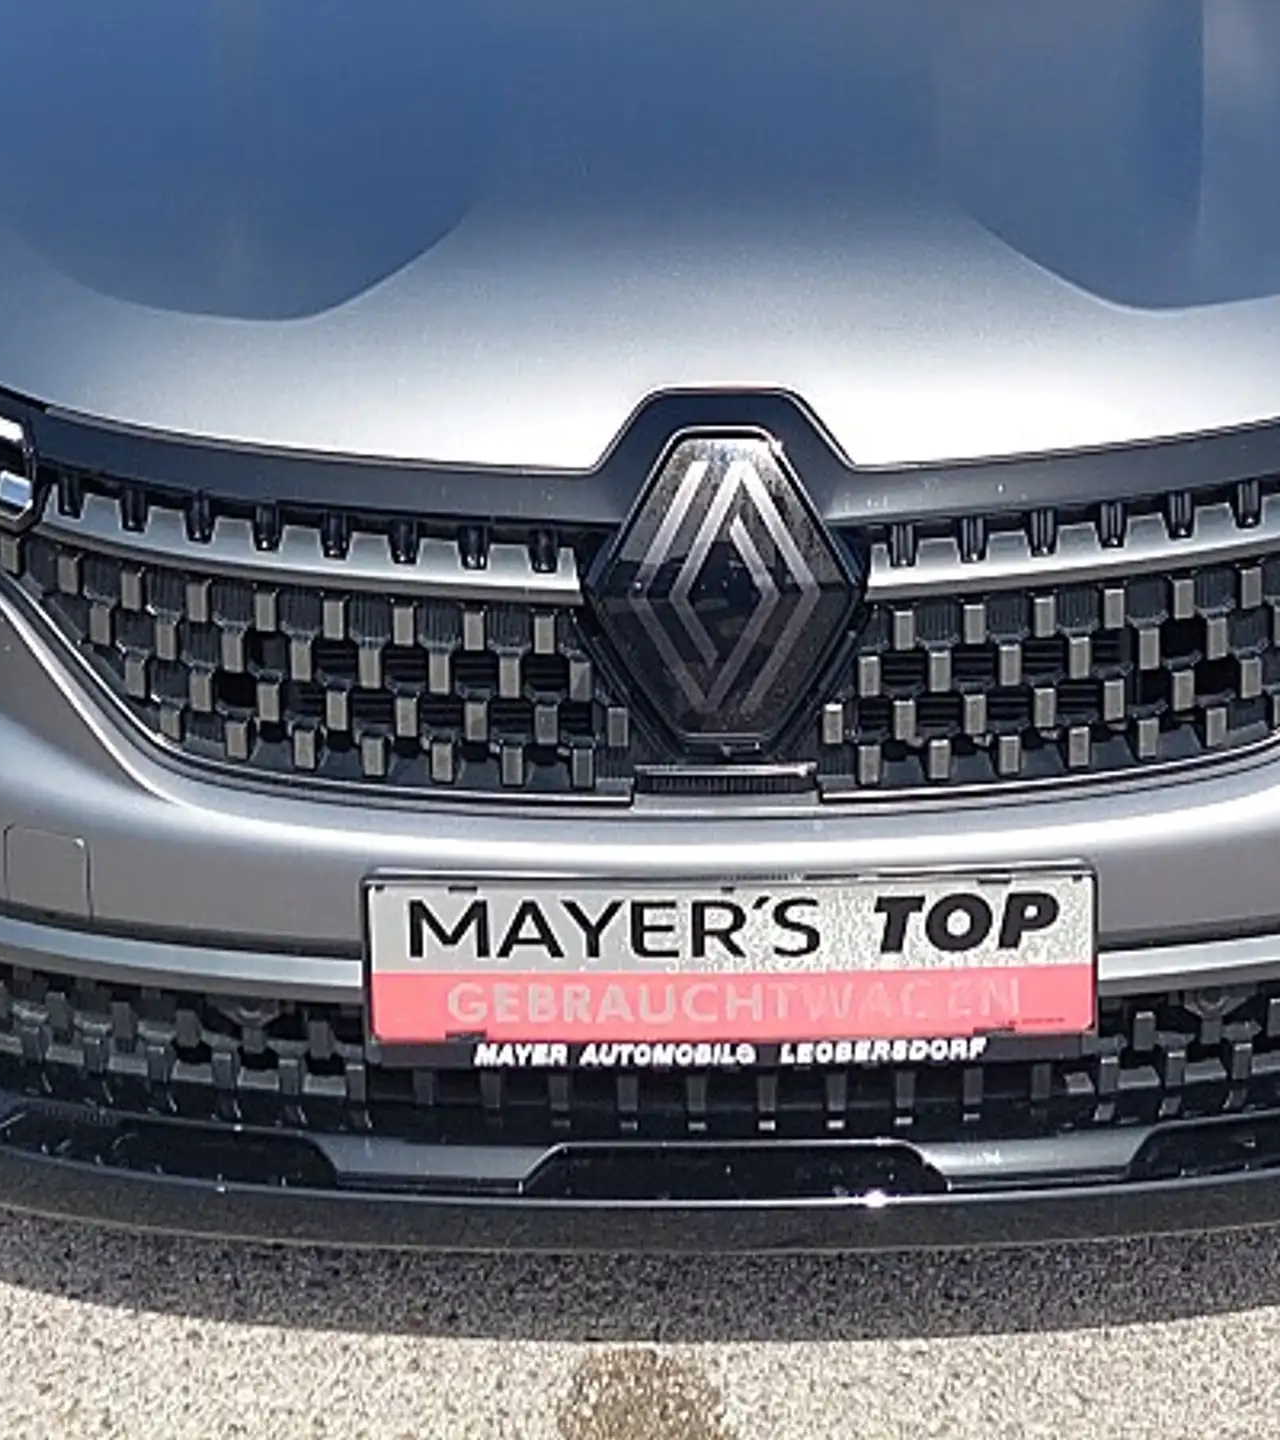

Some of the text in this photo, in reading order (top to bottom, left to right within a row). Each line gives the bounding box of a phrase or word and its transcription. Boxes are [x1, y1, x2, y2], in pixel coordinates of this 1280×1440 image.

[874, 892, 1060, 954] TOP
[473, 1043, 568, 1067] MAYER
[780, 1036, 987, 1064] LEOBERSDORF
